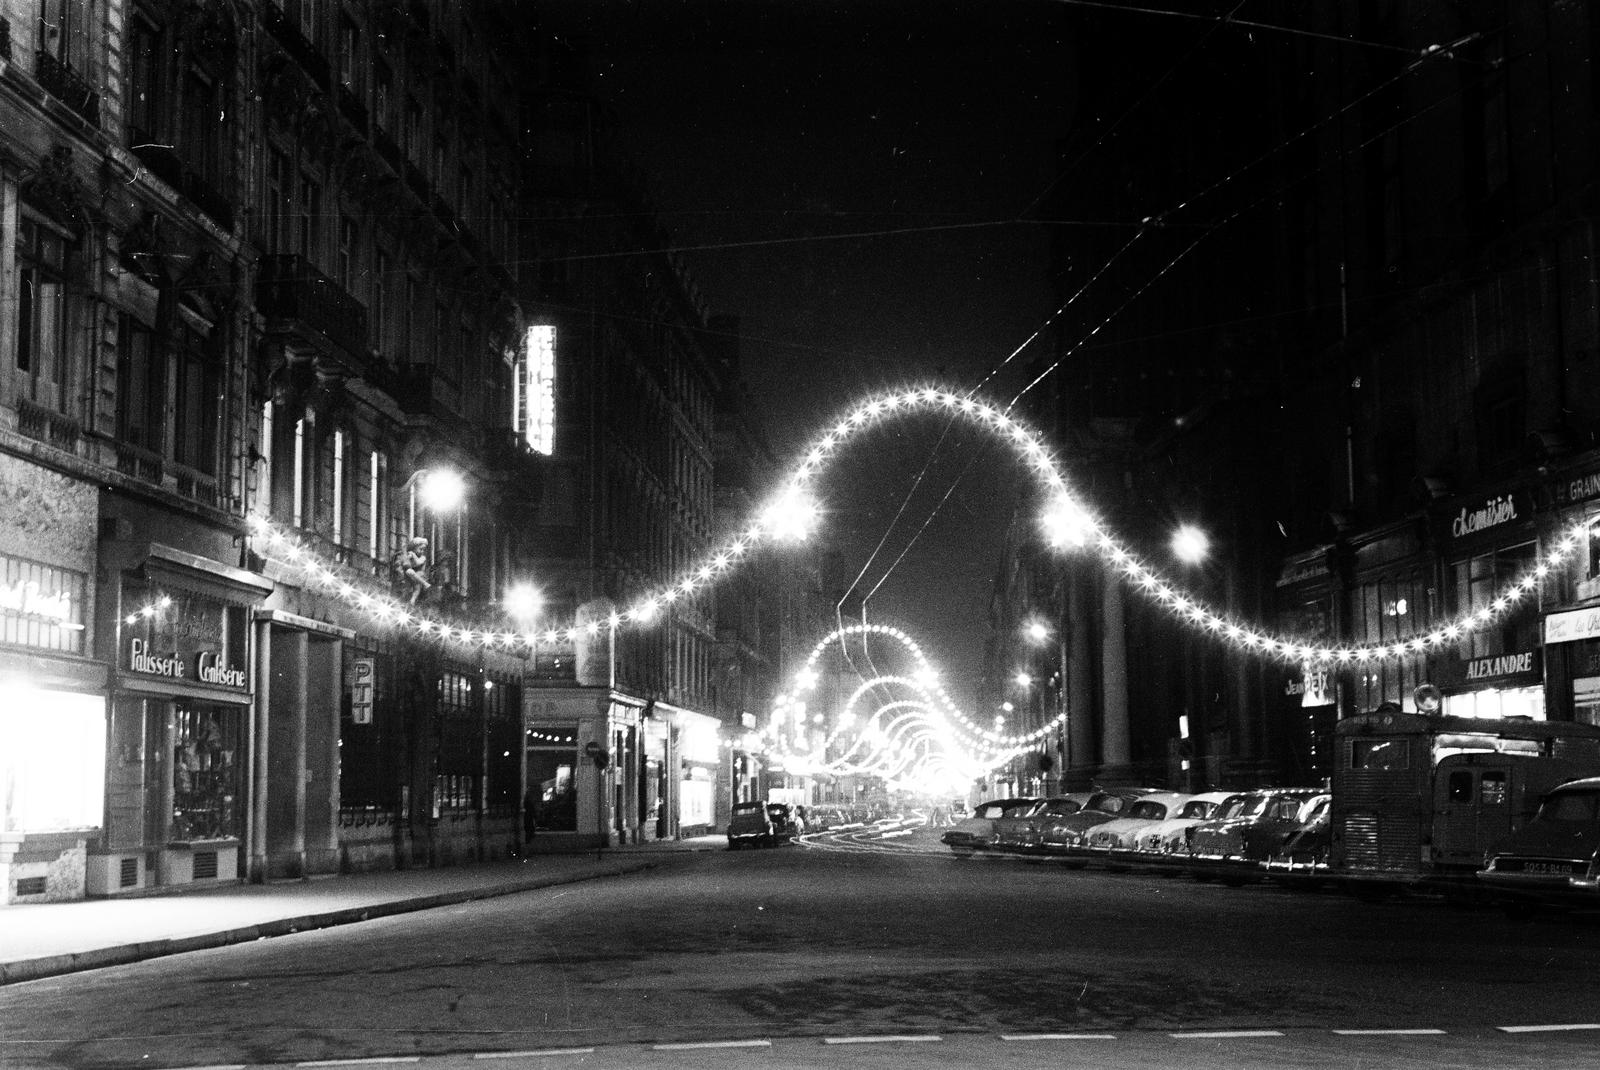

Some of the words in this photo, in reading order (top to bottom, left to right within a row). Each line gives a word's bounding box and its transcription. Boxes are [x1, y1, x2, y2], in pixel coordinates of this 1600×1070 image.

[198, 651, 246, 687] Confiserie
[1466, 651, 1533, 680] ALEXANDRE
[352, 657, 371, 722] PTT
